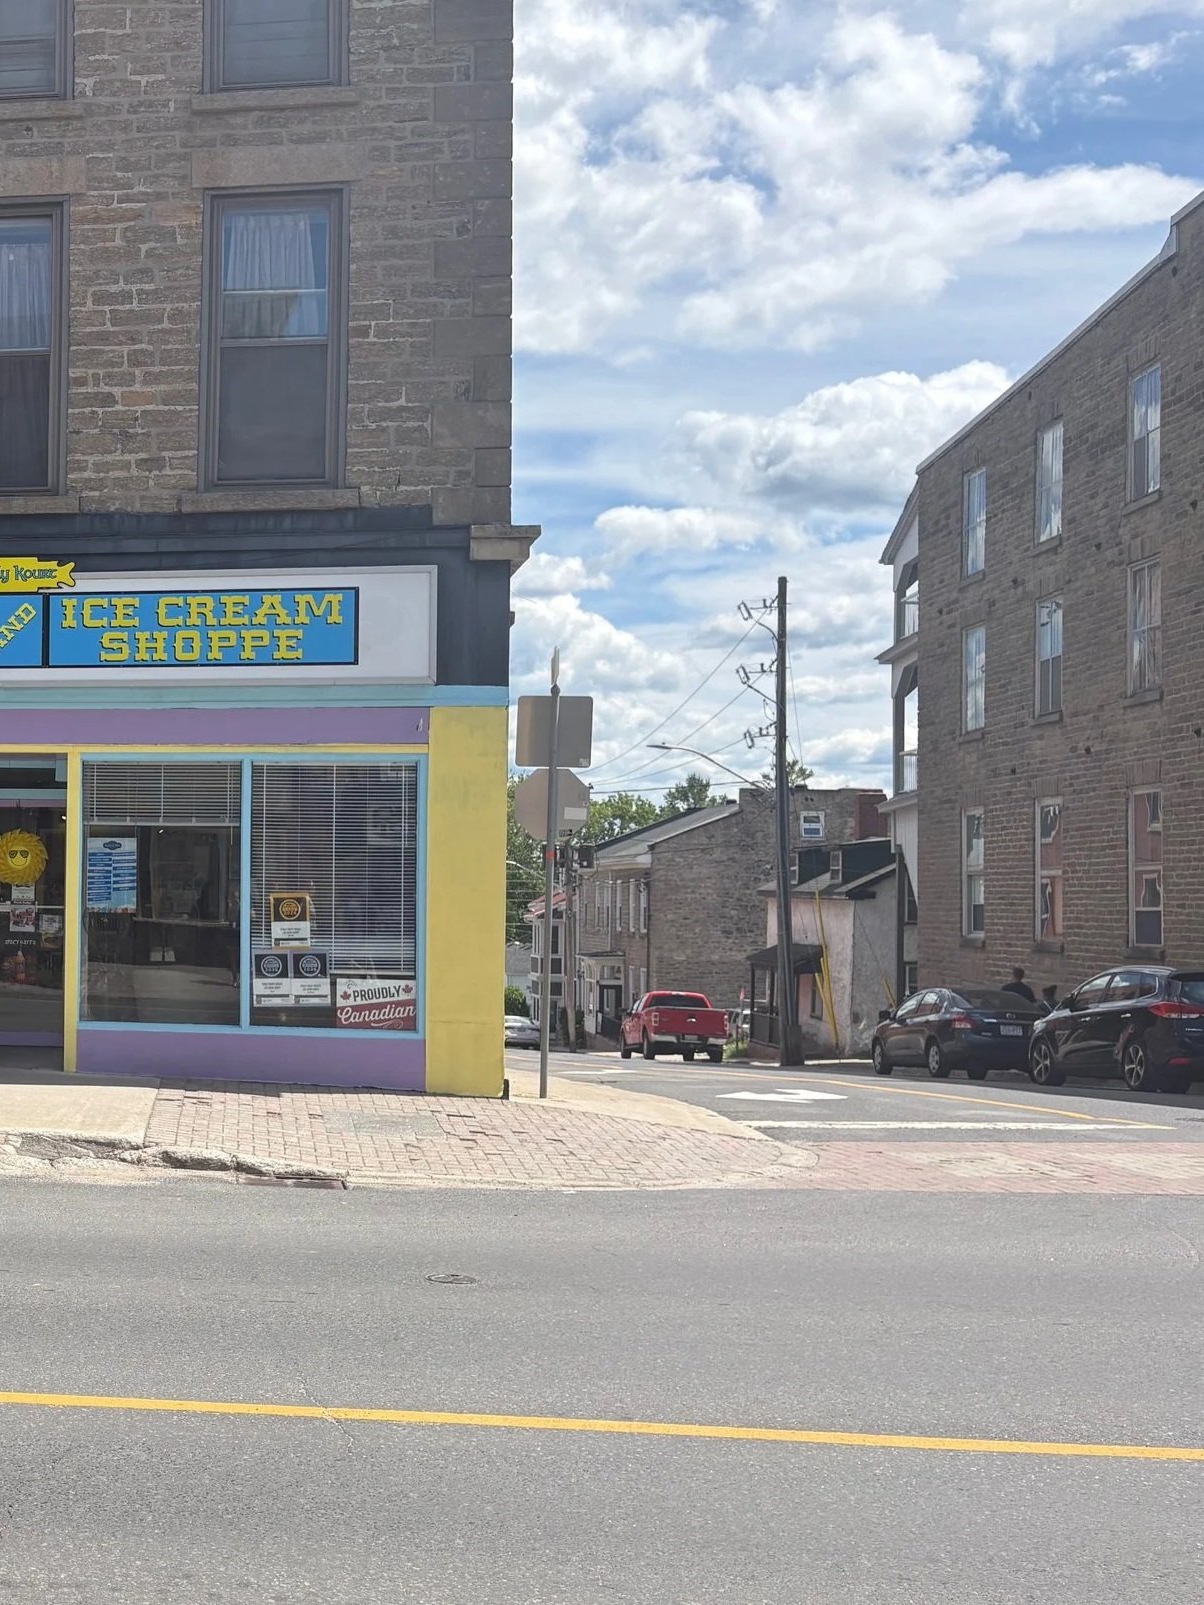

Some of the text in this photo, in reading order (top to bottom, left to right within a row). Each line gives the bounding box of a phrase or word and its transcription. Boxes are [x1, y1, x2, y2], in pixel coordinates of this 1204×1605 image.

[61, 593, 343, 629] ICE CREAM
[99, 629, 304, 662] SHOPPE
[352, 985, 401, 1002] PROUDLY
[337, 1004, 416, 1024] Canadian
